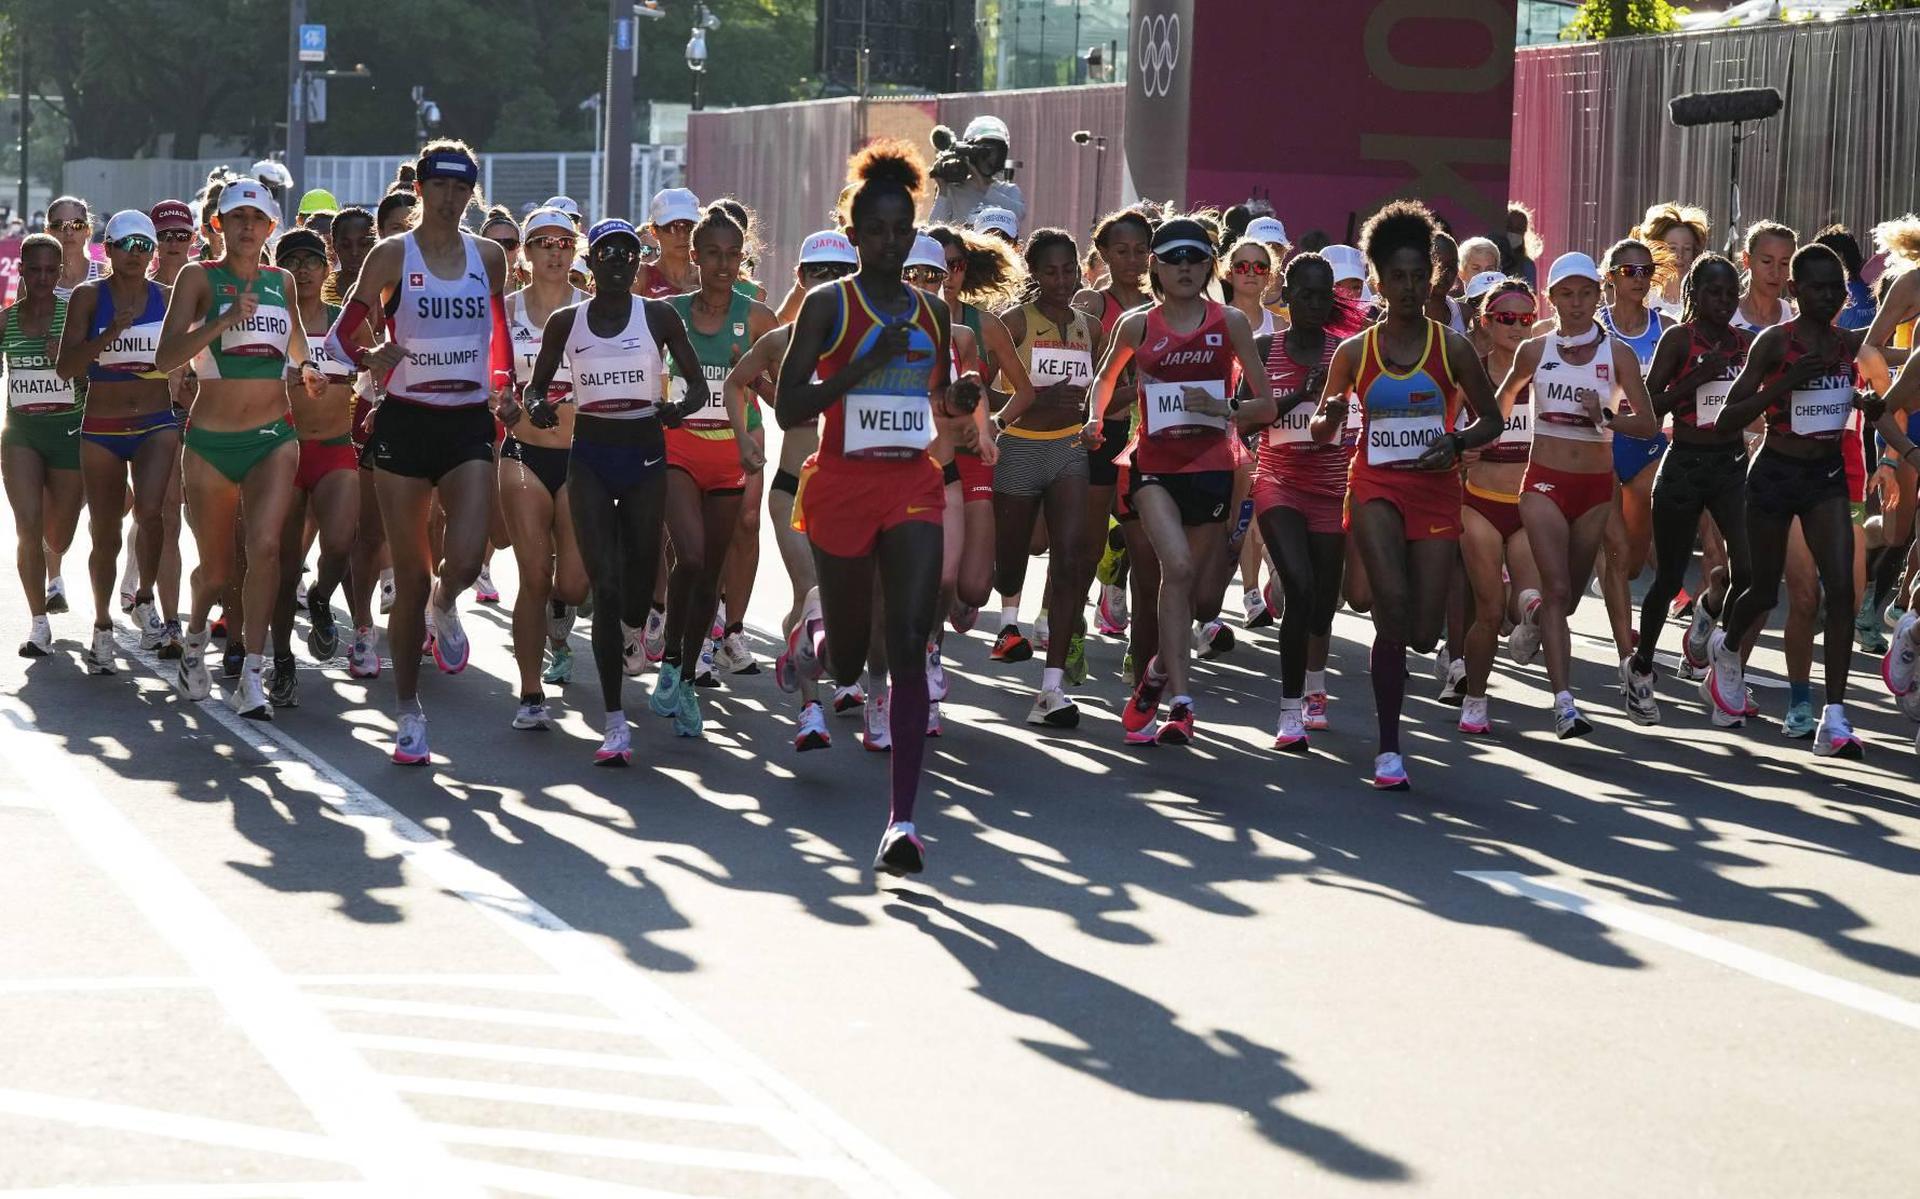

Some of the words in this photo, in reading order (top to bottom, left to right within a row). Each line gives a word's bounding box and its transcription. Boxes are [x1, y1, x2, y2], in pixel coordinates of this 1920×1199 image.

[158, 209, 189, 218] CANADA
[811, 239, 846, 250] JAPAN
[417, 296, 485, 319] SUISSE
[409, 349, 479, 367] SCHLUMPF
[1160, 350, 1214, 366] JAPAN
[1038, 358, 1088, 378] KEJETA
[580, 370, 645, 386] SALPETER
[10, 379, 72, 394] KHATALA
[859, 408, 924, 432] WELDU
